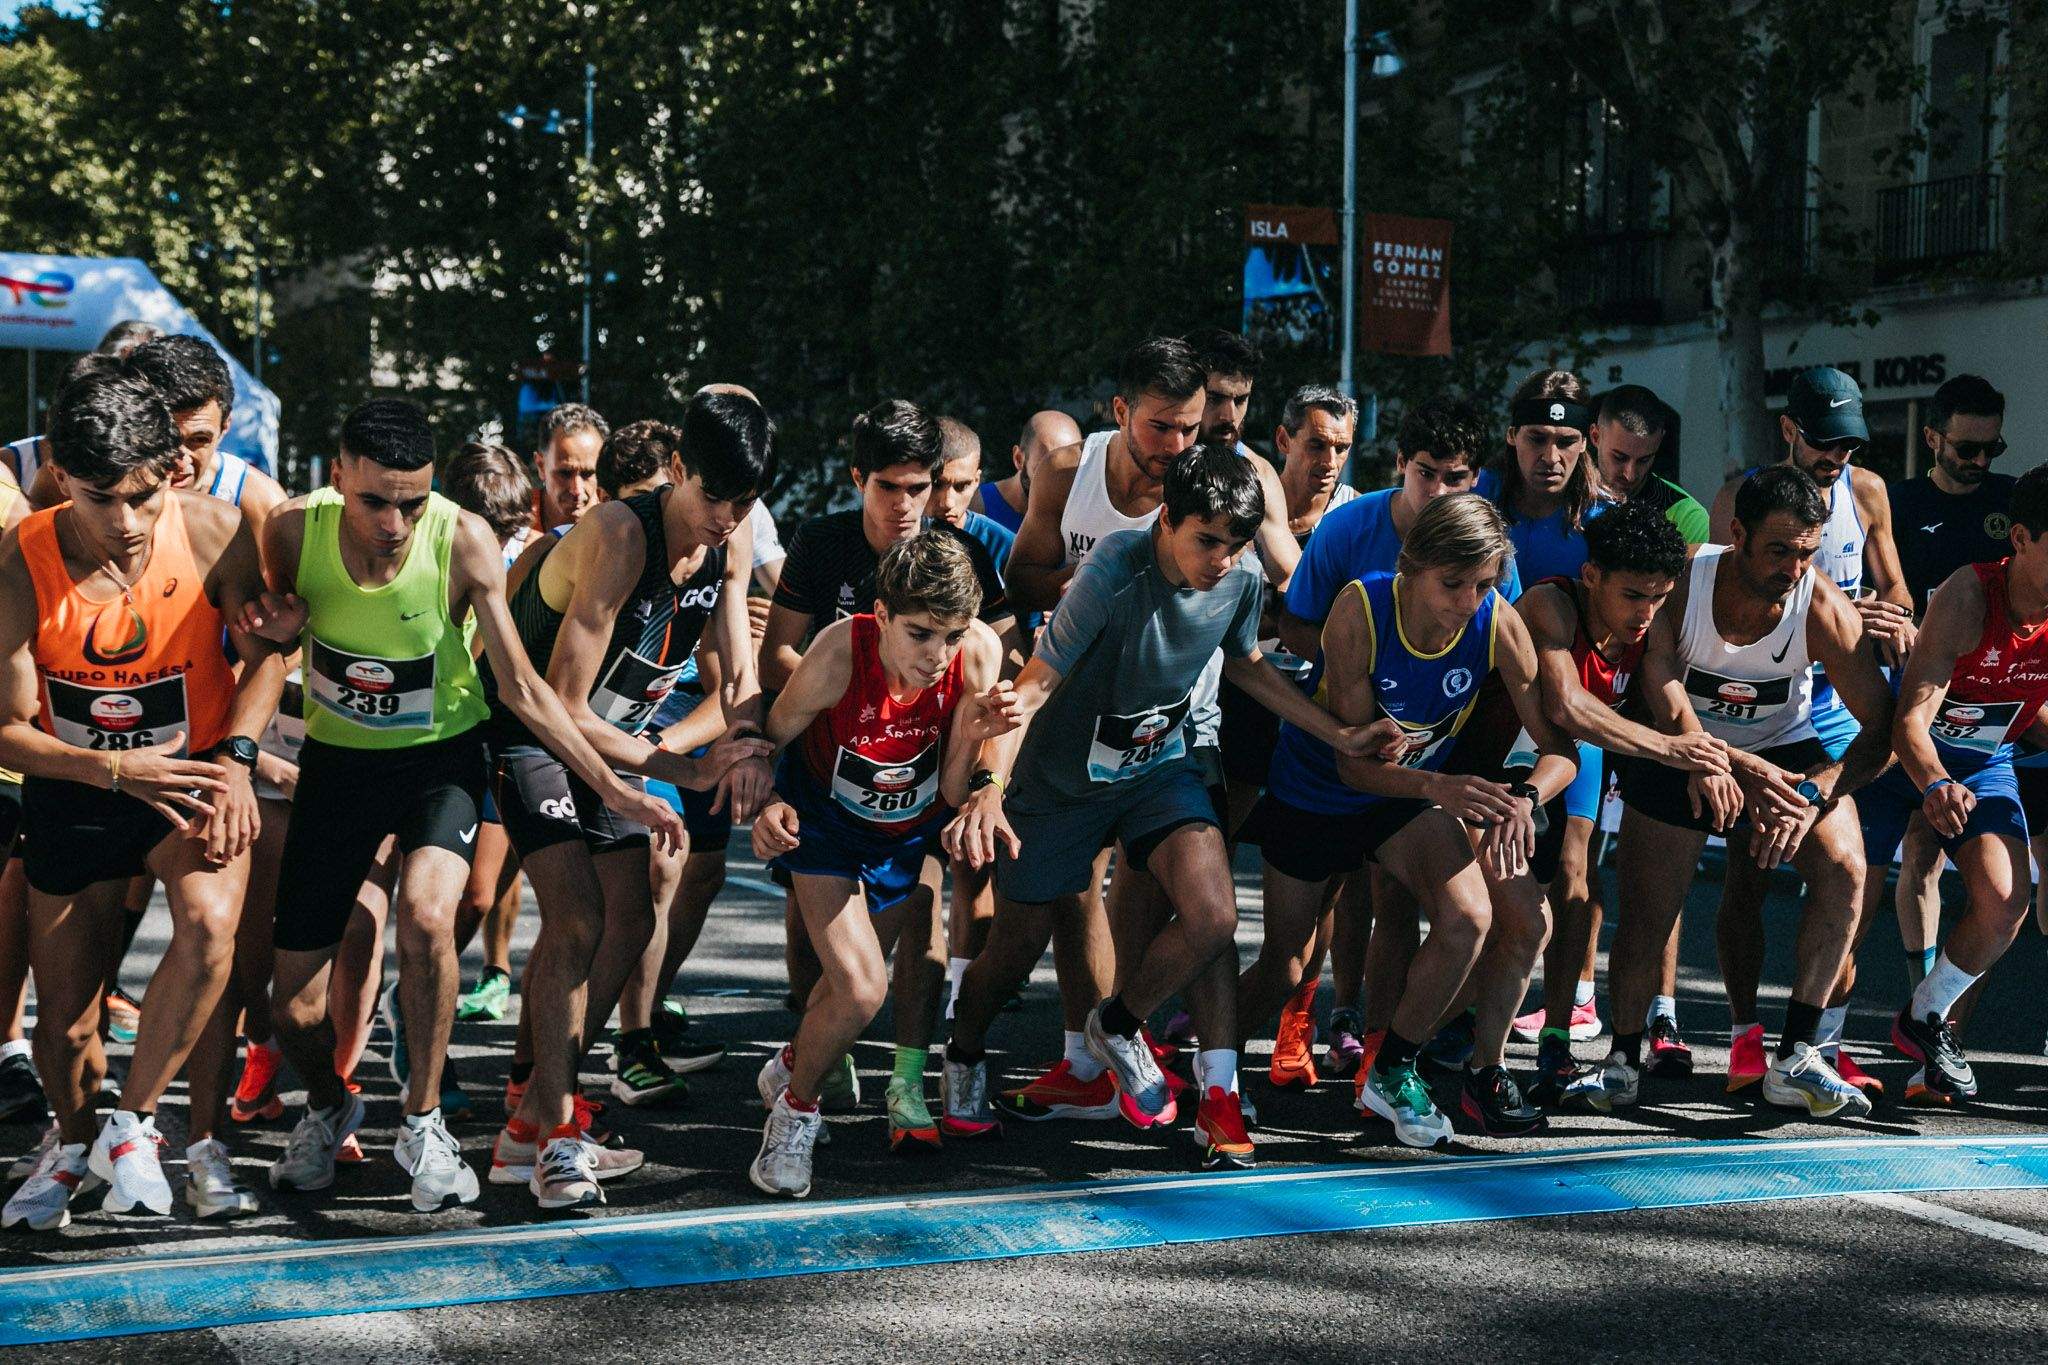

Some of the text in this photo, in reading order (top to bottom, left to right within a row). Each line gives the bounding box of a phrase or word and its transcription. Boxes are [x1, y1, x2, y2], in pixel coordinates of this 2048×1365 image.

[1251, 220, 1288, 238] ISLA
[1874, 353, 1946, 388] KORS
[336, 686, 400, 716] 239
[1707, 700, 1757, 719] 291
[86, 728, 154, 751] 286
[859, 789, 918, 811] 260
